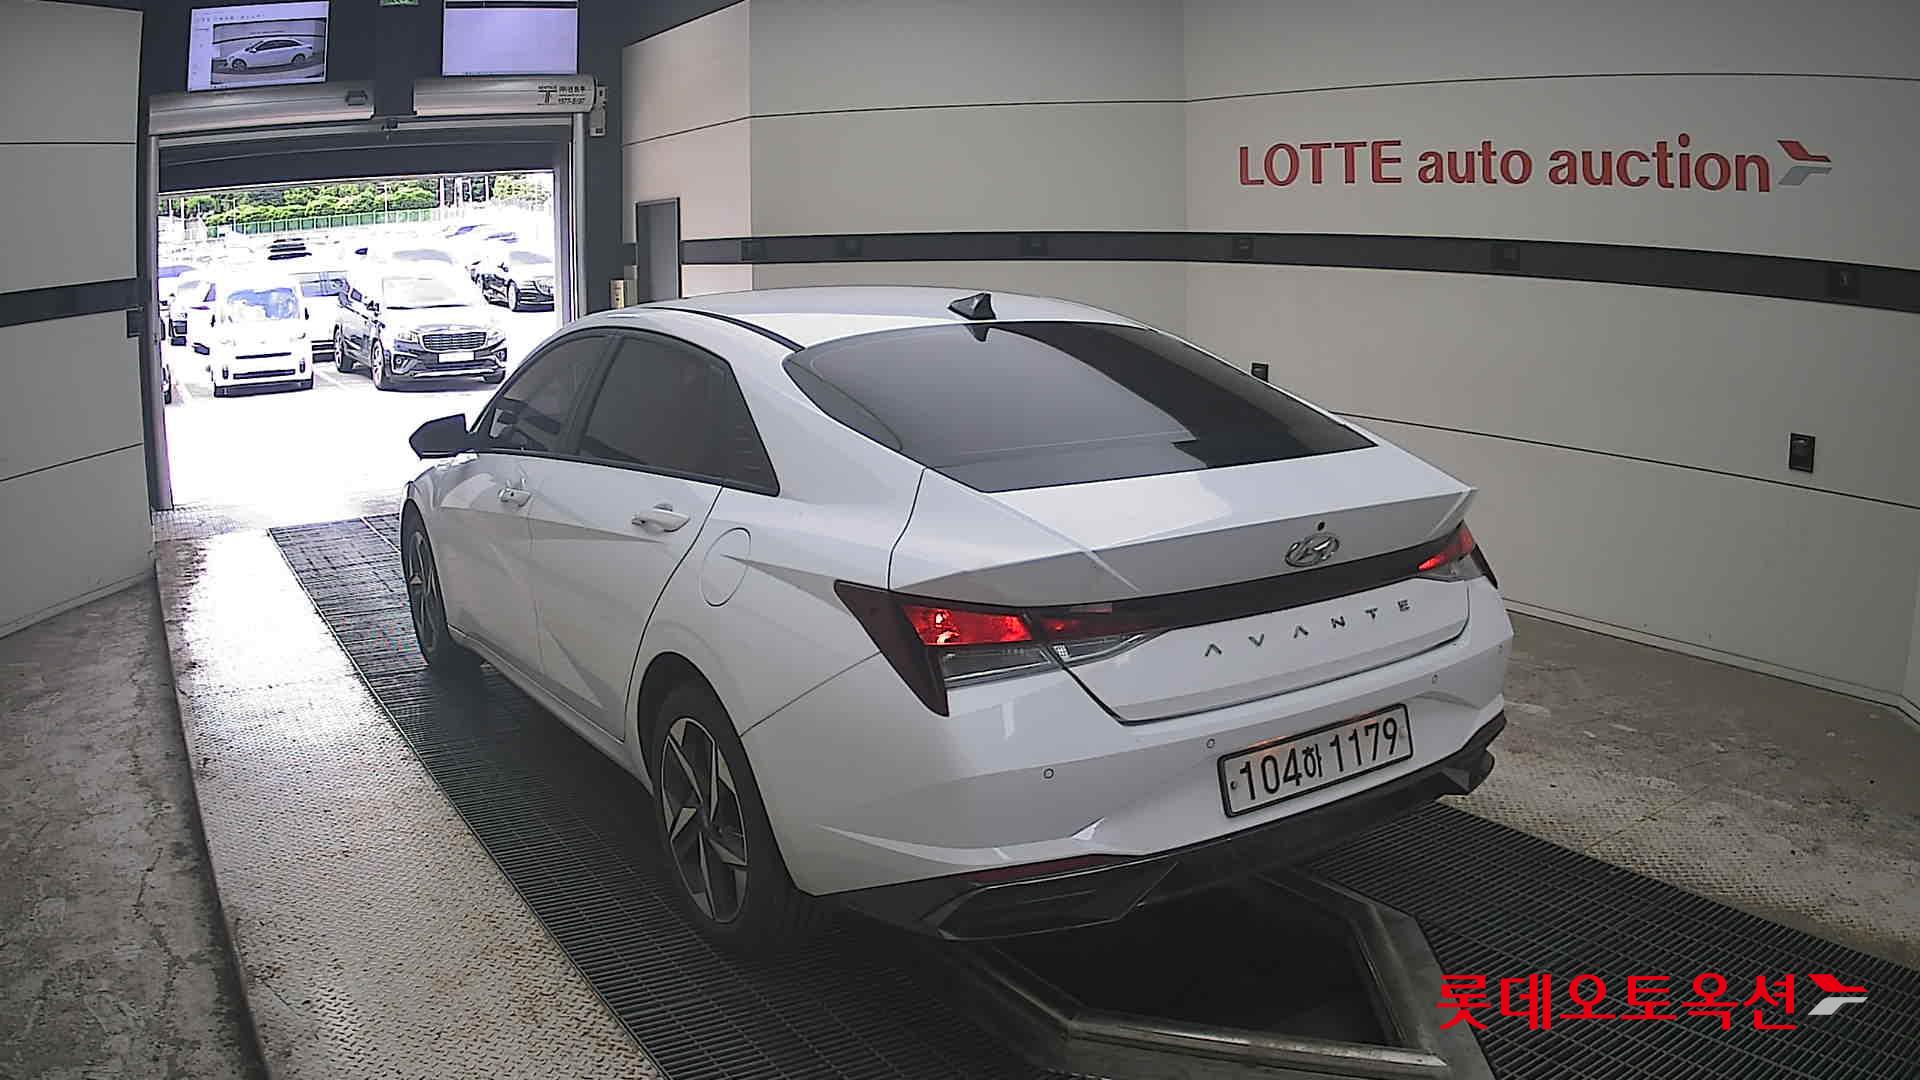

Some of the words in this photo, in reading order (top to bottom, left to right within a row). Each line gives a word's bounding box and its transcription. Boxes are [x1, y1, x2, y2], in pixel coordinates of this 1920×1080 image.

[1239, 140, 1402, 186] LOTTE
[1417, 140, 1533, 185] auto
[1548, 133, 1771, 193] auction
[1204, 599, 1411, 657] AVANTE
[1329, 717, 1398, 773] 1179
